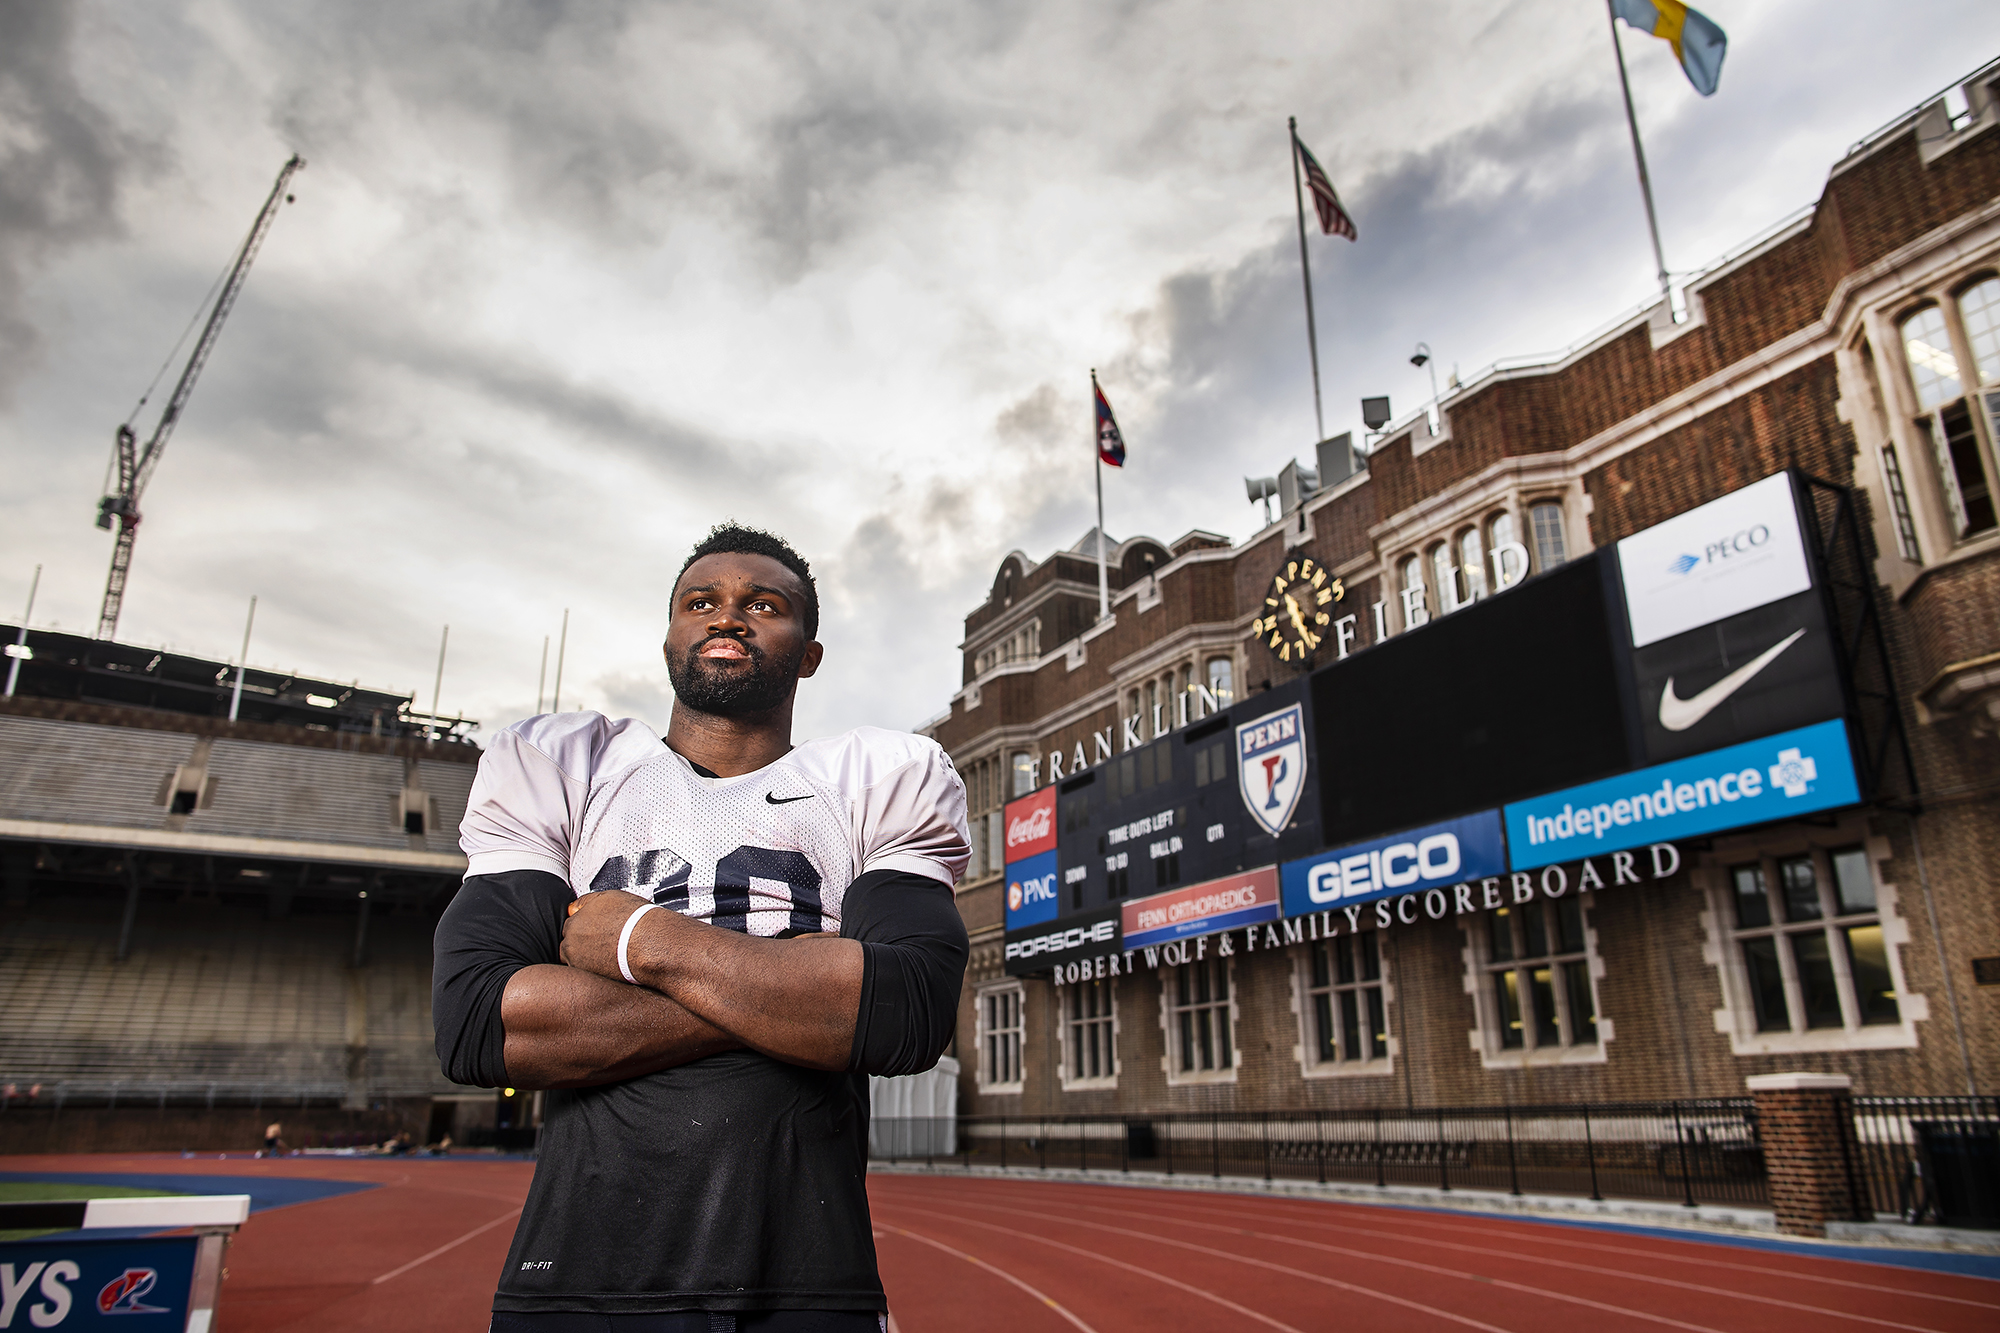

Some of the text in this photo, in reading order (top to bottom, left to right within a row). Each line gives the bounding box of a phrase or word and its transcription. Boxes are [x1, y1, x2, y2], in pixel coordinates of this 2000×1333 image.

[1704, 524, 1769, 563] PECO
[1334, 541, 1530, 661] FIELD
[1029, 676, 1221, 791] FRANKLIN
[1242, 714, 1296, 754] PENN
[1108, 825, 1129, 845] TIME
[1152, 809, 1174, 832] LEFT
[1527, 768, 1763, 846] Independence
[1023, 873, 1057, 905] PNC
[1308, 832, 1461, 904] GEICO
[1053, 842, 1681, 986] ROBERT WOLF & FAMILY SCOREBOARD
[1138, 907, 1167, 929] PENN
[1168, 885, 1257, 922] ORTHOPAEDICS
[1005, 920, 1115, 961] PORSCHE
[521, 1261, 553, 1271] DRI-FIT
